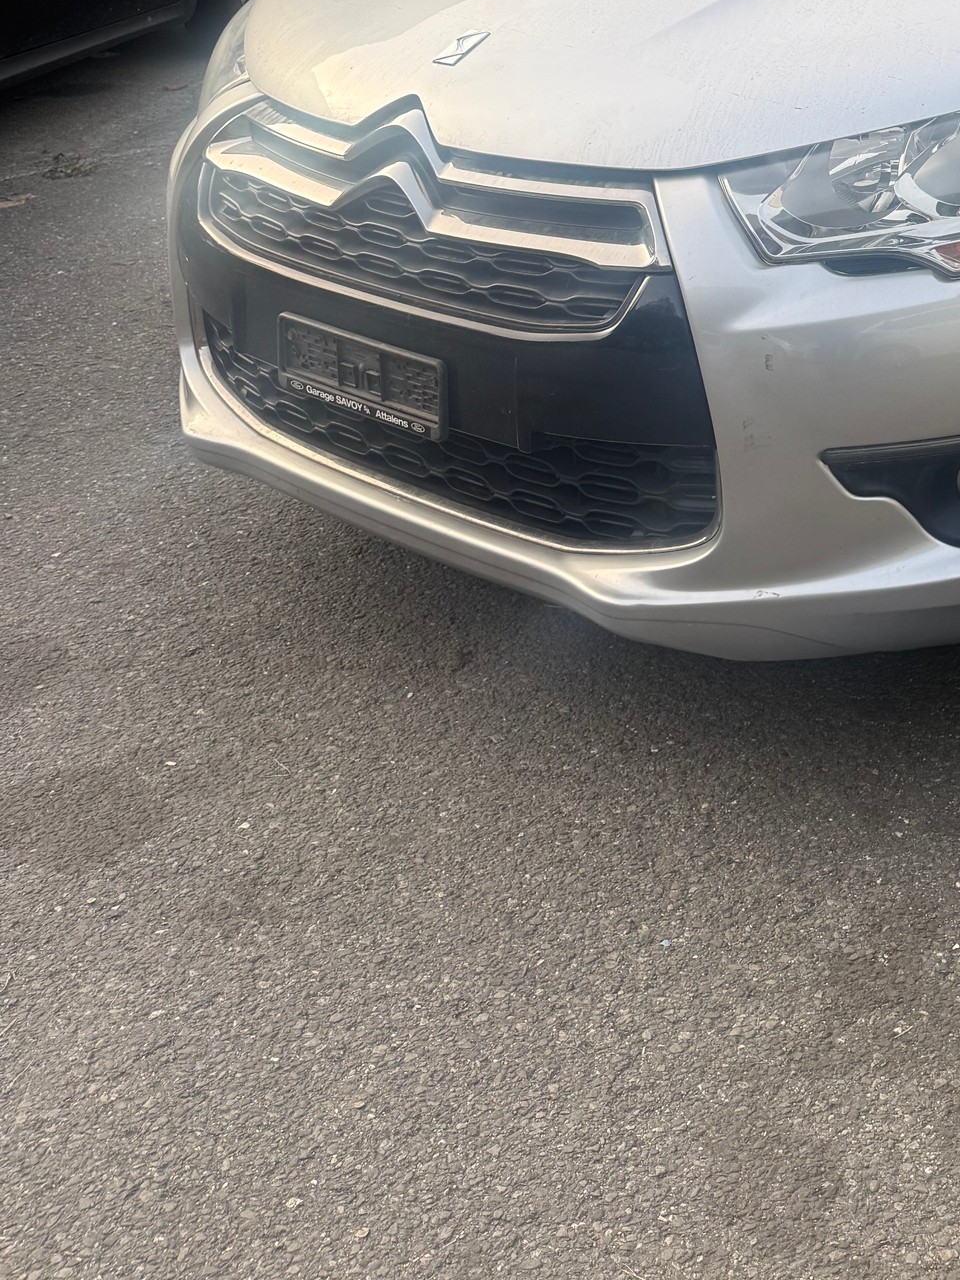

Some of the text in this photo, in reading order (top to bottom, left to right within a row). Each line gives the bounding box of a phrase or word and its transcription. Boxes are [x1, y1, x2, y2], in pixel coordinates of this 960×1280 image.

[306, 385, 335, 402] Garage
[335, 395, 363, 412] SAVOY
[375, 410, 409, 428] Attalens
